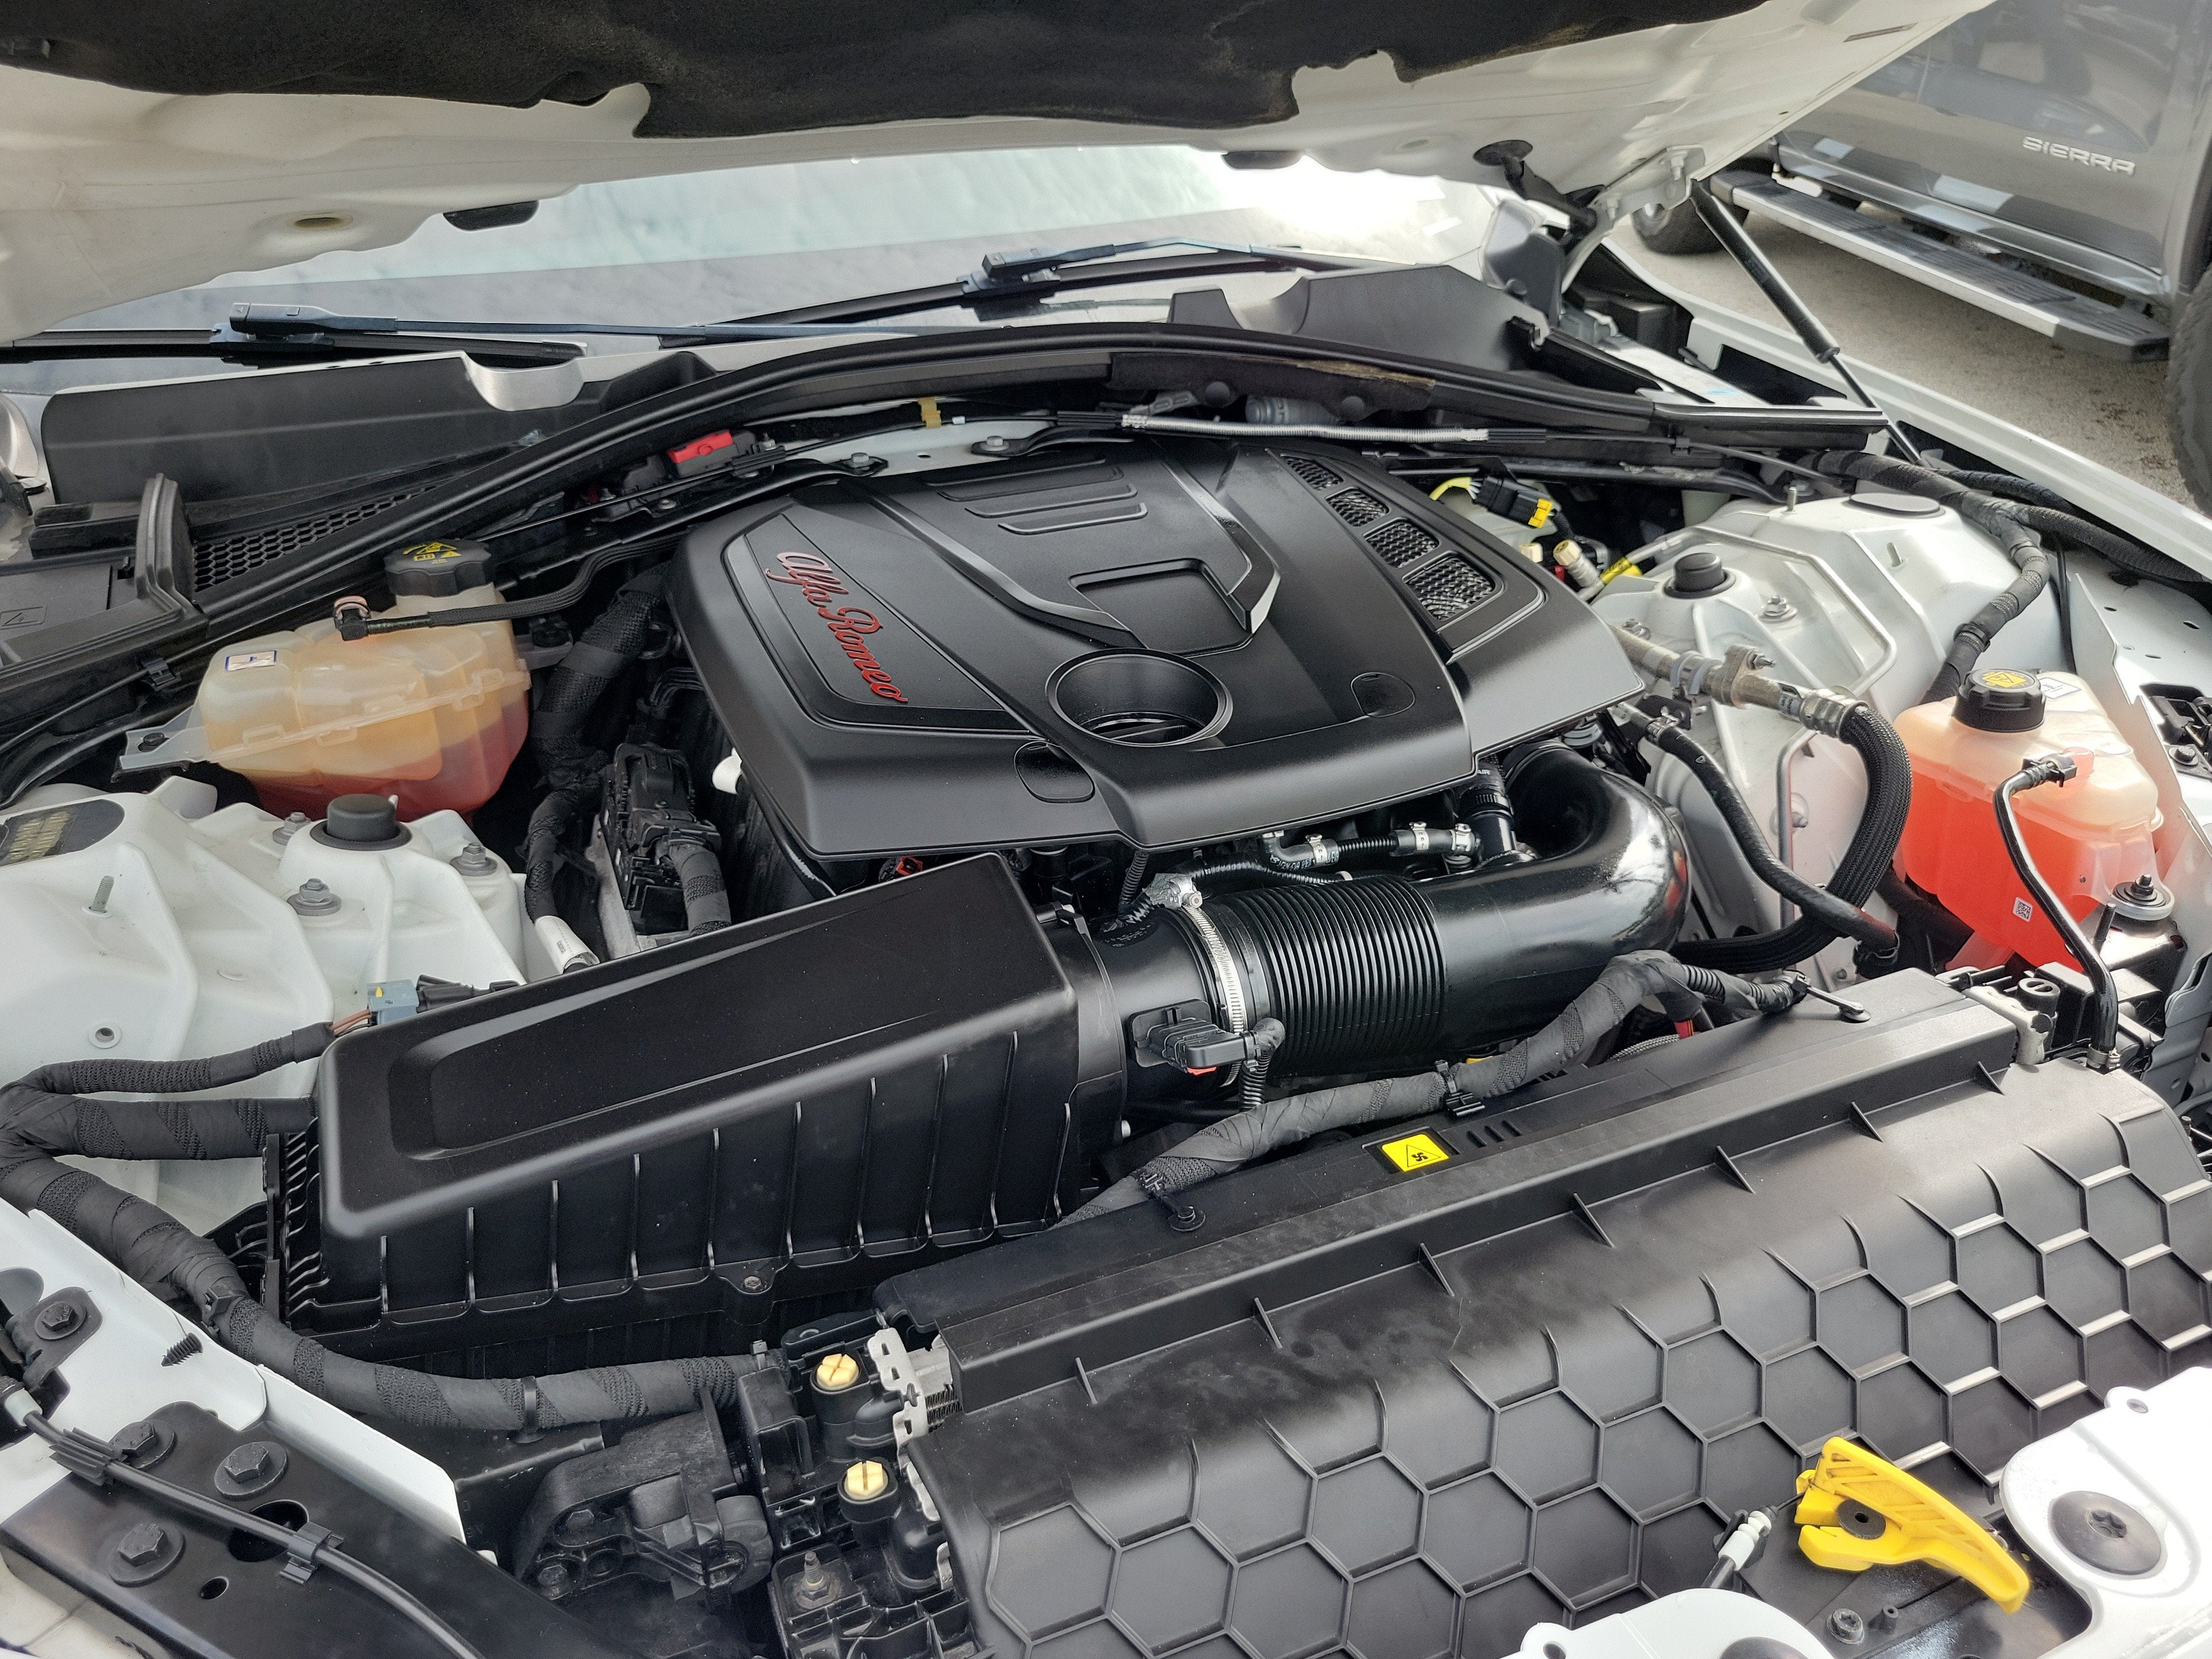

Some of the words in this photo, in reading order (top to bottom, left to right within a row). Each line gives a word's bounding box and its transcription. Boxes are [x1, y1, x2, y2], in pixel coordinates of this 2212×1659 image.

[2023, 136, 2135, 176] SIERRA
[766, 552, 849, 607] Alfa
[817, 607, 908, 702] Romeo
